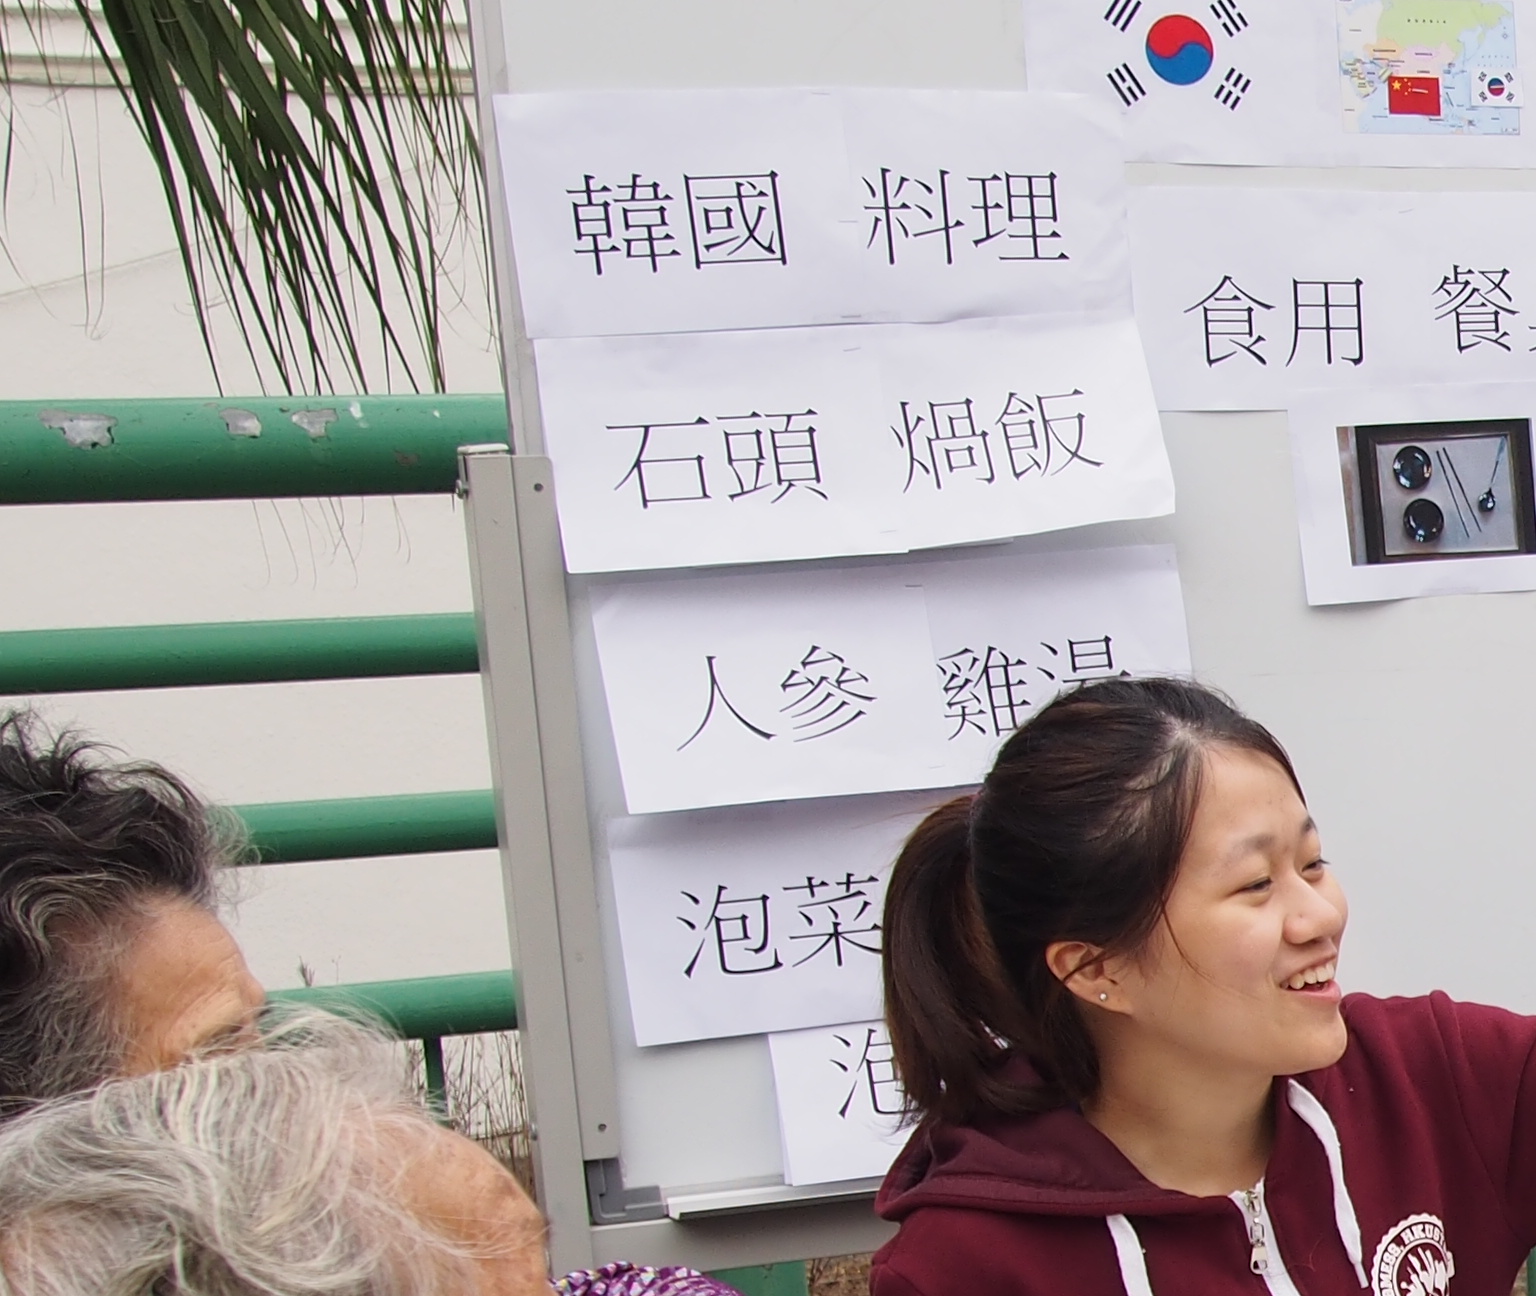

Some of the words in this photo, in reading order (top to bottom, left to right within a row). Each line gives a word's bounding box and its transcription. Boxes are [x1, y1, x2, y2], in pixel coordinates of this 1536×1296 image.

[565, 169, 789, 276] 韓國
[861, 167, 1070, 266] 料理
[1183, 274, 1364, 368] 食用
[605, 408, 829, 510] 石頭
[677, 644, 878, 751] 人參
[676, 872, 887, 979] 泡菜
